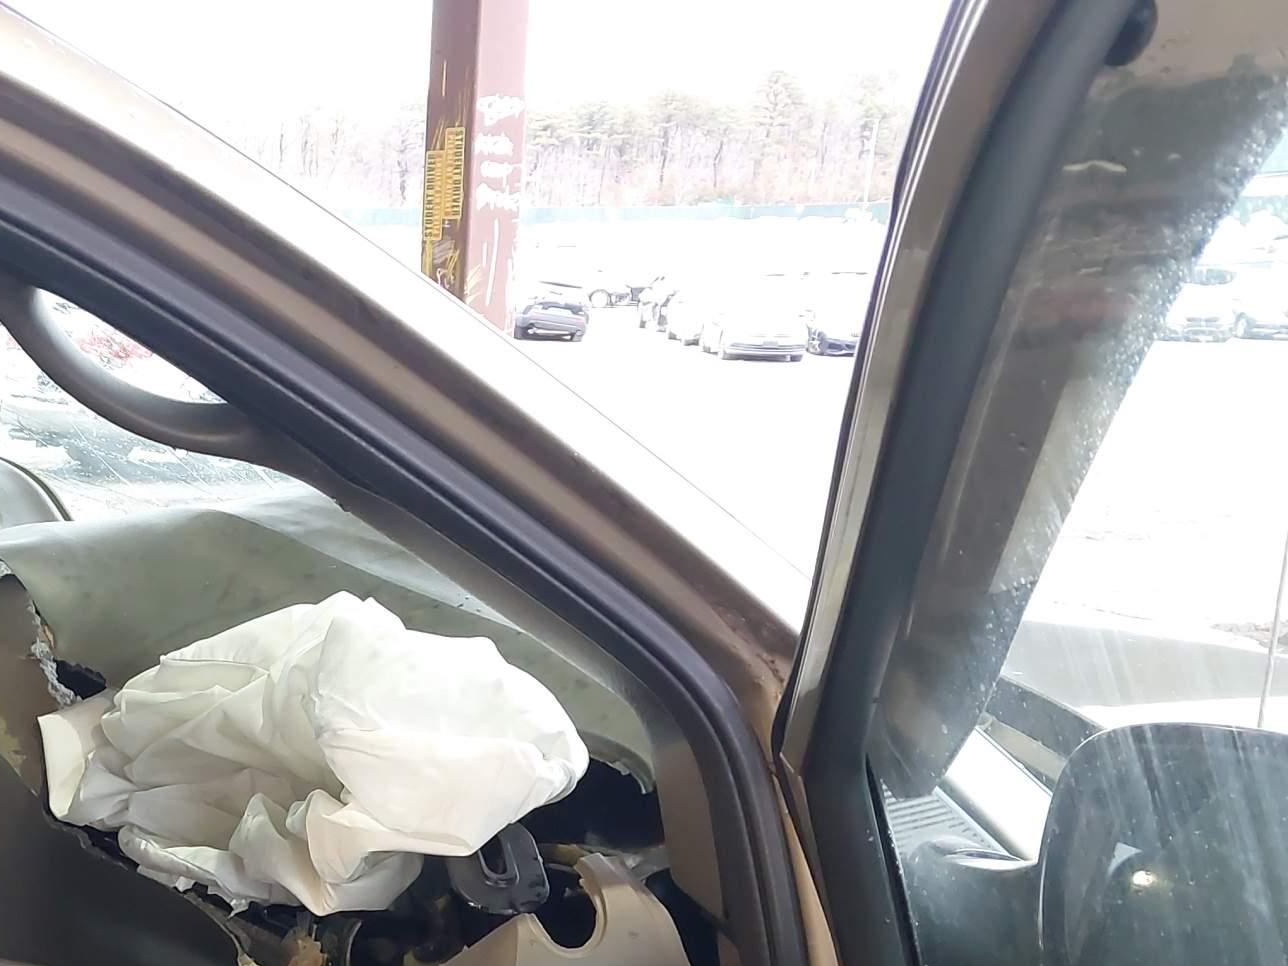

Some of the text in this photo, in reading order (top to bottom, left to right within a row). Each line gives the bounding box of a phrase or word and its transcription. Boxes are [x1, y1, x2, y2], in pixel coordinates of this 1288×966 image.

[425, 154, 435, 238] STUDENT DRIVER
[452, 130, 464, 216] STUDENT DRIVER
